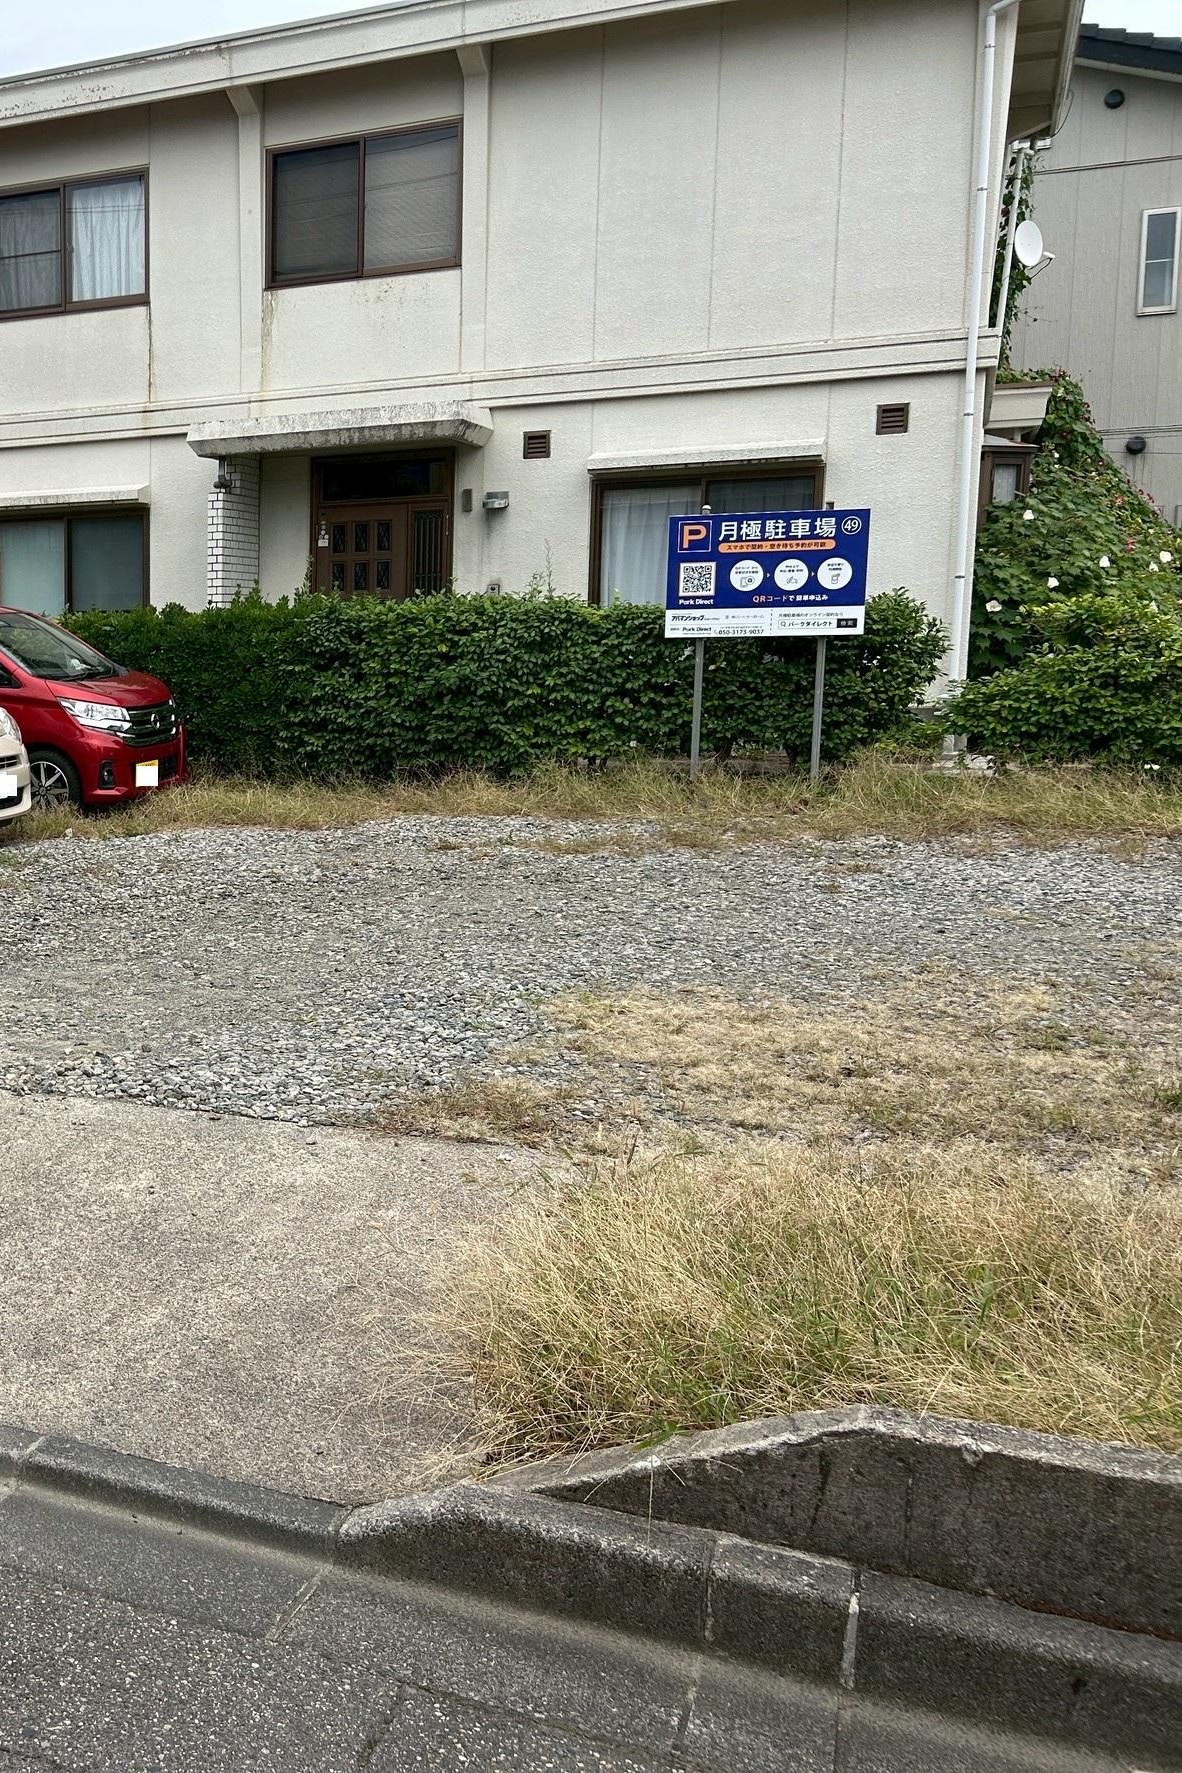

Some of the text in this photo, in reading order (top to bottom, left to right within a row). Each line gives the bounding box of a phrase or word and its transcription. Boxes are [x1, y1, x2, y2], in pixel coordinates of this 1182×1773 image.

[682, 524, 707, 549] P
[718, 517, 837, 541] 月極駐車場
[843, 518, 860, 532] 49
